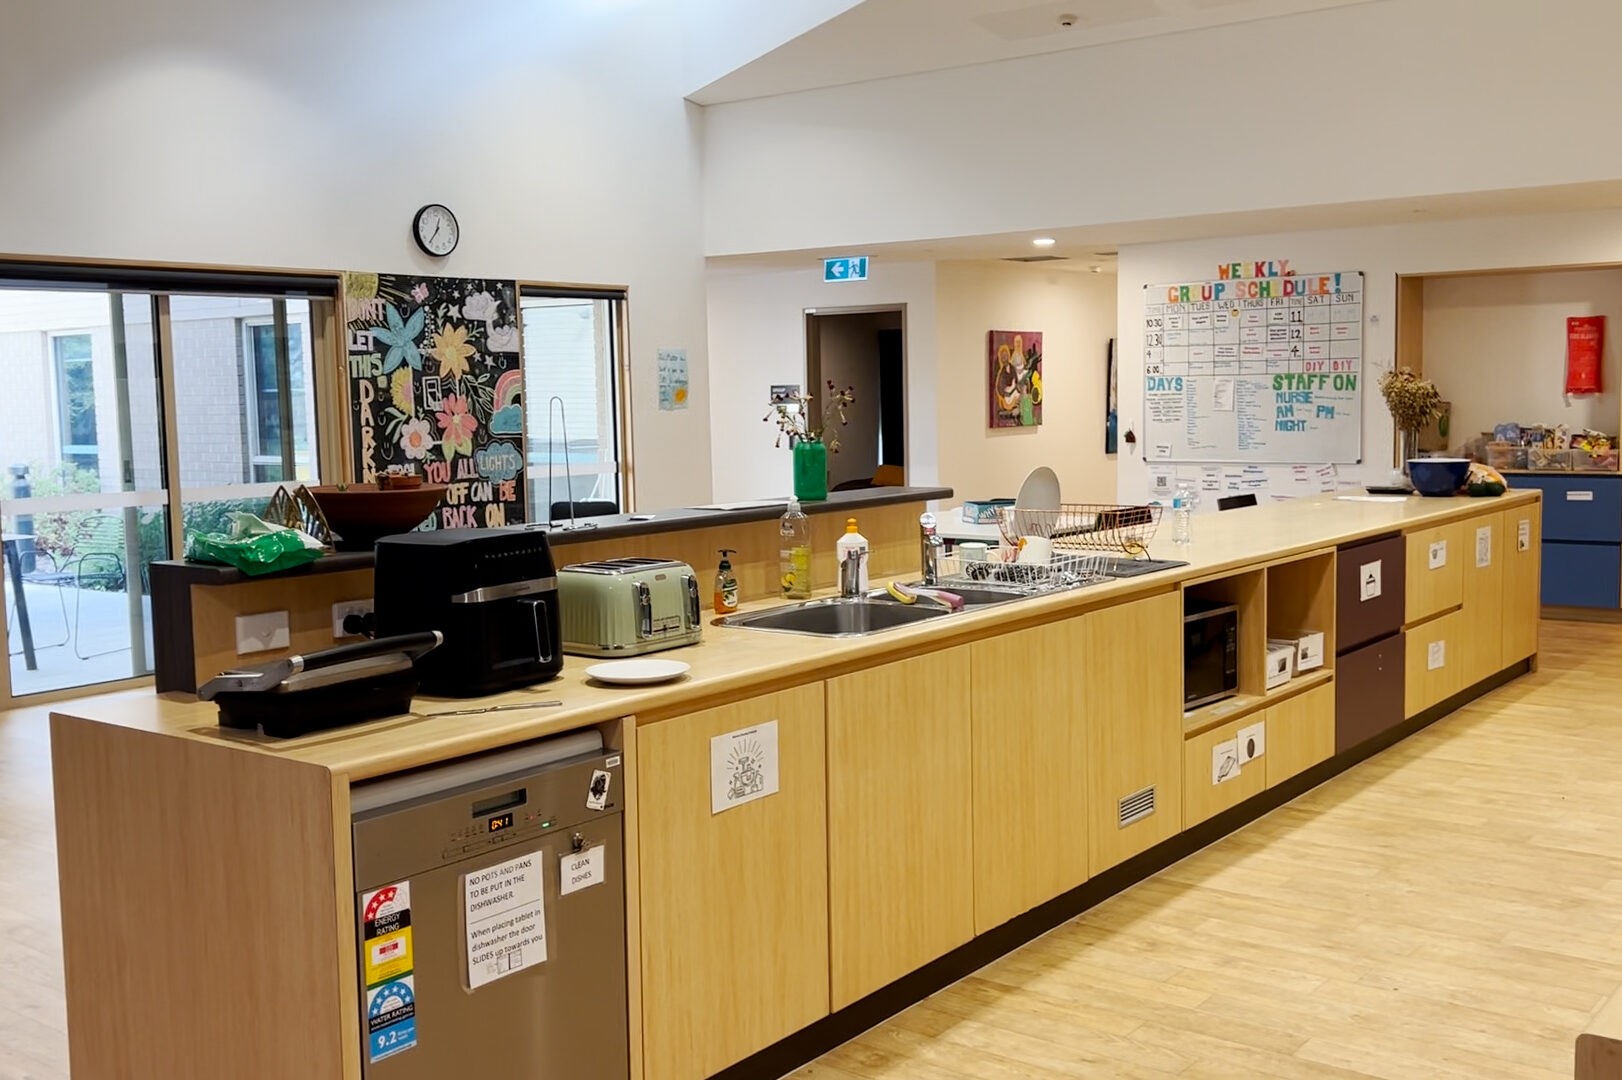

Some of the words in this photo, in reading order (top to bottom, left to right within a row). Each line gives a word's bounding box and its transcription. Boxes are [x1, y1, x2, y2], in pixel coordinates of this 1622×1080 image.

[1166, 304, 1186, 314] MON
[1191, 303, 1210, 311] TUES
[1218, 300, 1235, 309] WED
[1270, 297, 1284, 306] FRI
[1307, 296, 1324, 304] SAT
[1335, 294, 1354, 303] SUN
[349, 329, 374, 351] LET
[350, 353, 383, 378] THIS
[1305, 361, 1325, 371] DIY
[1333, 360, 1352, 371] DIY
[1147, 376, 1183, 391] DAYS
[1273, 374, 1330, 391] STAFF
[1333, 374, 1357, 391] ON
[1276, 391, 1313, 404] NURSE
[1276, 404, 1294, 418] AM
[1316, 405, 1335, 419] PM
[1275, 420, 1307, 432] NIGHT
[423, 461, 451, 484] YOU
[457, 458, 479, 479] ALL
[480, 454, 516, 471] LIGHTS
[446, 482, 470, 505] OFF
[471, 481, 494, 502] CAN
[499, 480, 517, 501] BE
[442, 505, 478, 530] BACK
[469, 876, 481, 887] NO
[481, 870, 498, 883] POTS
[499, 864, 514, 876] AND
[514, 859, 532, 873] PANS
[571, 858, 590, 872] CLEAN
[470, 890, 480, 899] TO
[480, 886, 489, 896] BE
[490, 881, 503, 893] PUT
[504, 878, 512, 888] IN
[512, 873, 526, 885] THE
[571, 871, 592, 885] DISHES
[374, 912, 400, 928] ENERGY
[376, 922, 400, 936] RATING
[471, 925, 491, 940] When
[491, 916, 515, 934] placing
[515, 910, 534, 924] tablet
[534, 908, 541, 917] in
[471, 933, 508, 953] dishwasher
[509, 926, 520, 939] the
[520, 923, 537, 934] door
[472, 951, 494, 966] SLIDES
[494, 947, 504, 957] up
[504, 938, 530, 954] towards
[530, 933, 543, 945] you
[370, 1014, 391, 1026] WATER
[391, 1004, 413, 1018] RATING
[378, 1030, 398, 1048] 9.2
